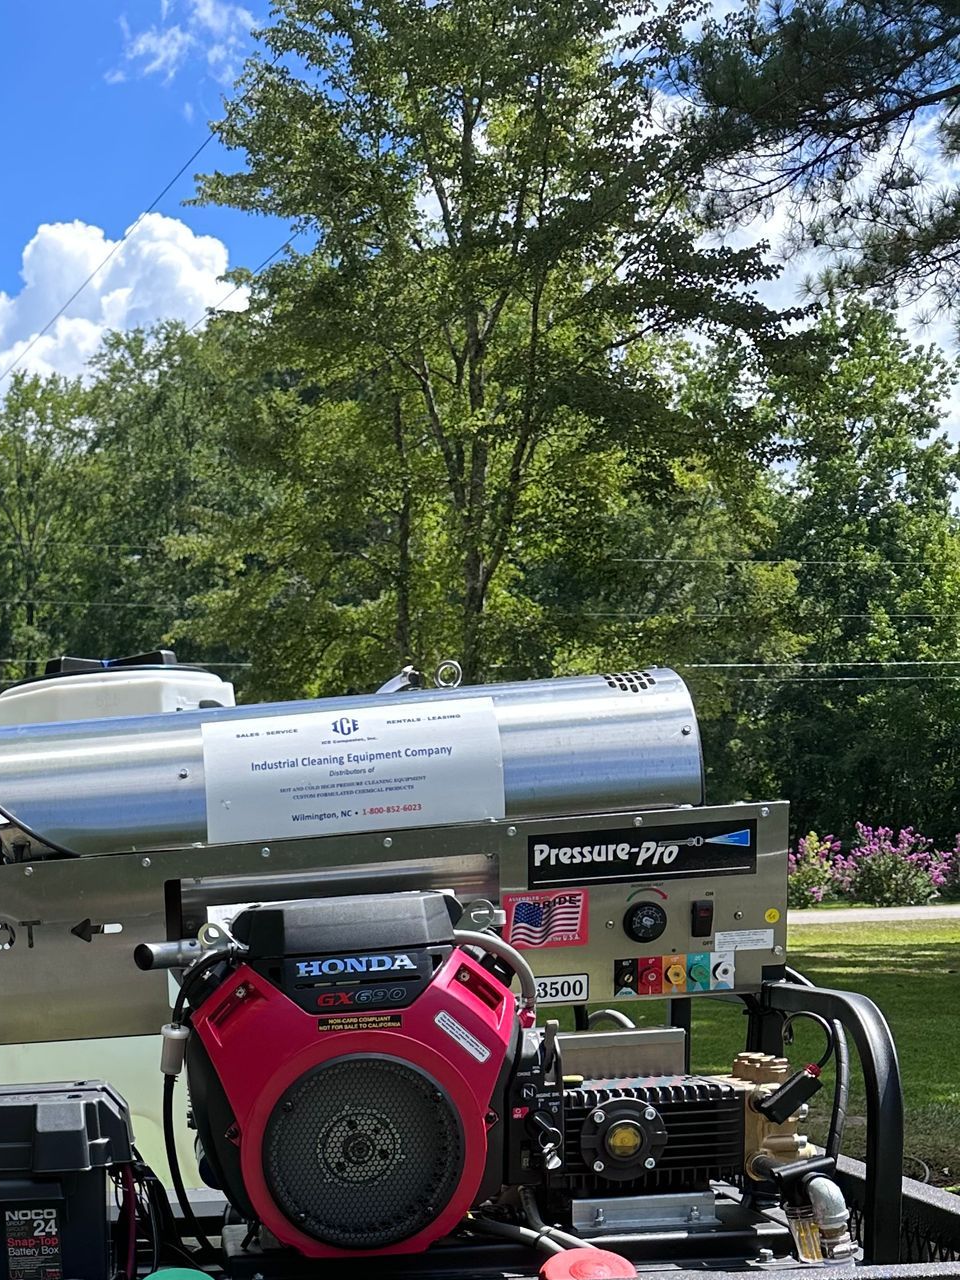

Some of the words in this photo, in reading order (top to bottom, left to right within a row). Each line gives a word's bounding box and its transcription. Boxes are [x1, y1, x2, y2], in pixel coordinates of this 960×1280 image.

[331, 717, 359, 736] ICE
[251, 758, 298, 771] Industrial
[301, 752, 344, 766] Cleaning
[347, 749, 402, 763] Equipment
[404, 745, 453, 758] Company
[329, 768, 366, 777] Distributors
[292, 812, 339, 822] Wilmington,
[341, 809, 352, 817] NC
[362, 803, 422, 816] 1-800-852-6023
[533, 841, 679, 867] Pressure-Pro
[532, 896, 577, 909] PRIDE
[296, 954, 417, 977] HONDA
[318, 988, 406, 1006] GX690
[536, 979, 583, 998] 3500
[6, 1209, 56, 1220] NOCO
[33, 1219, 58, 1237] 24
[7, 1236, 59, 1248] Snap-Top
[8, 1247, 39, 1256] Battery
[41, 1246, 59, 1255] Box
